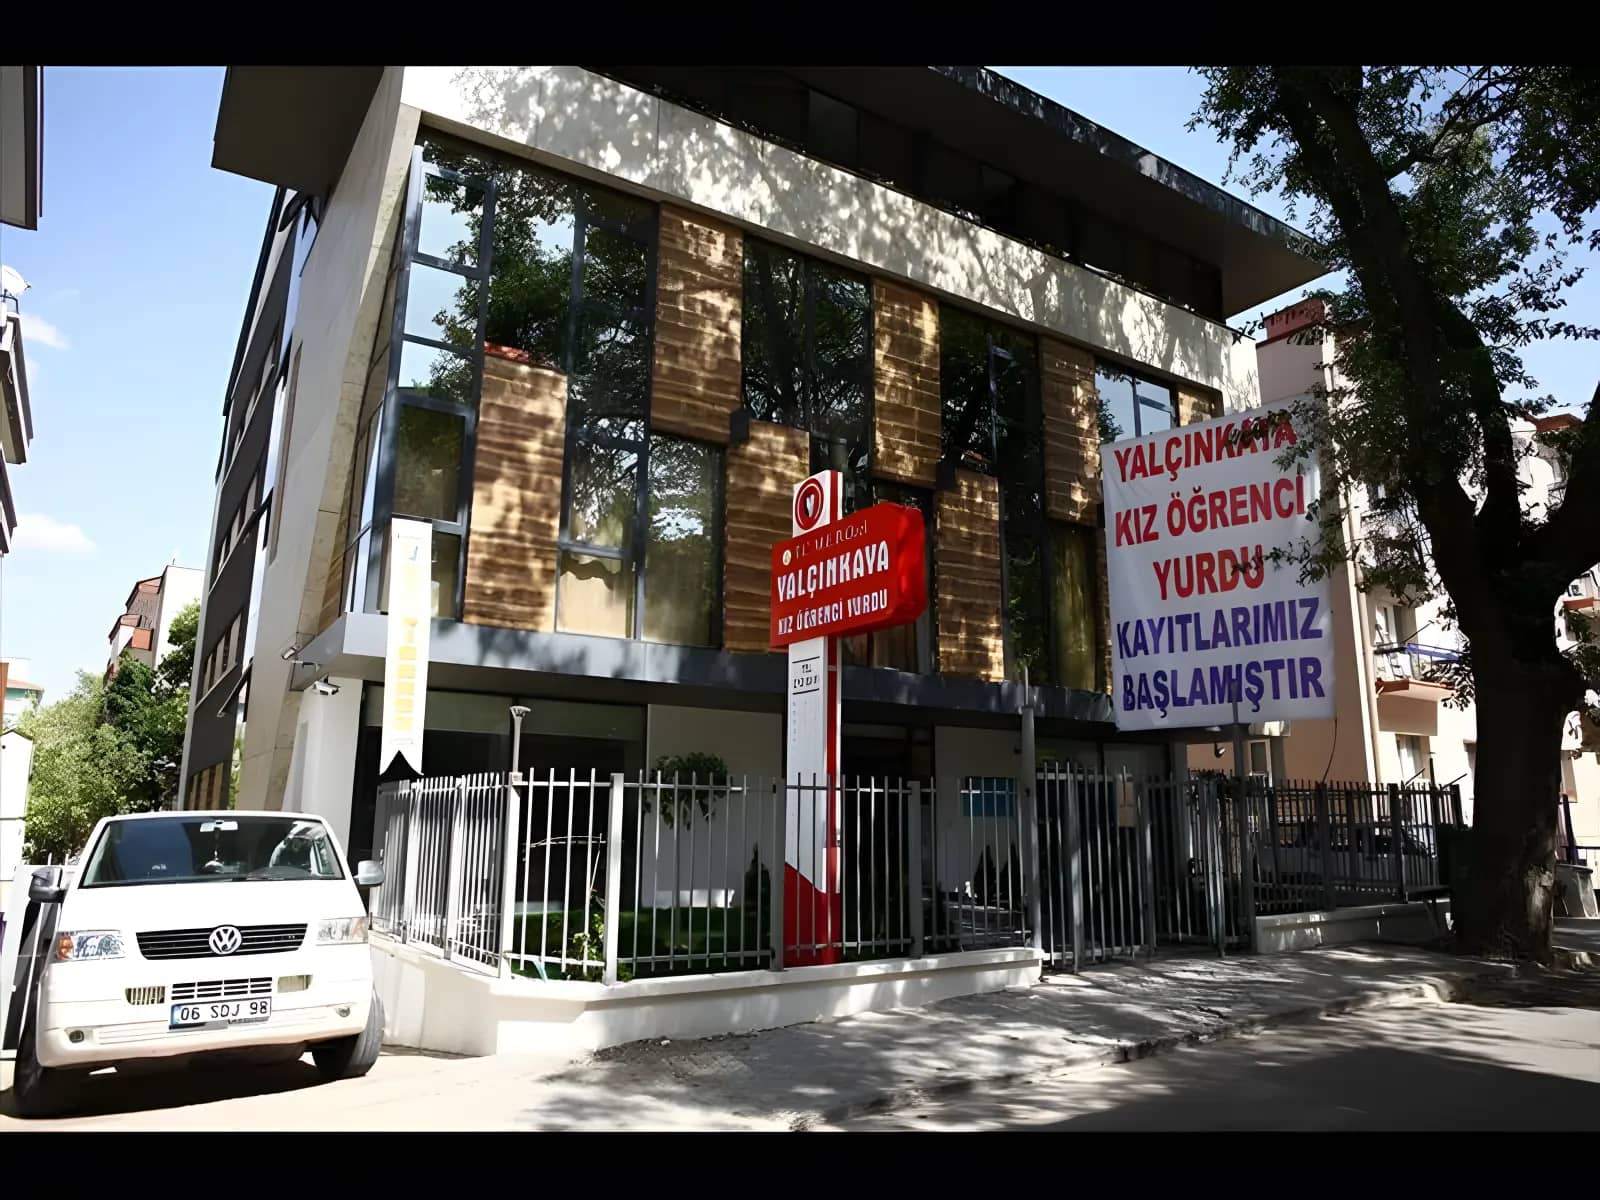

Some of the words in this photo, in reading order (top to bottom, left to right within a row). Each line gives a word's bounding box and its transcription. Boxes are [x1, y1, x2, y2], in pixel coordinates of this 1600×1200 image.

[1115, 504, 1159, 547] KIZ
[1167, 464, 1305, 537] ÖĞRENCİ
[777, 540, 889, 602] YALÇINKAYA
[1153, 544, 1265, 600] YURDU
[1116, 597, 1323, 659] KAYITLARIMIZ
[1122, 657, 1326, 718] BAŞLAMIŞTIR
